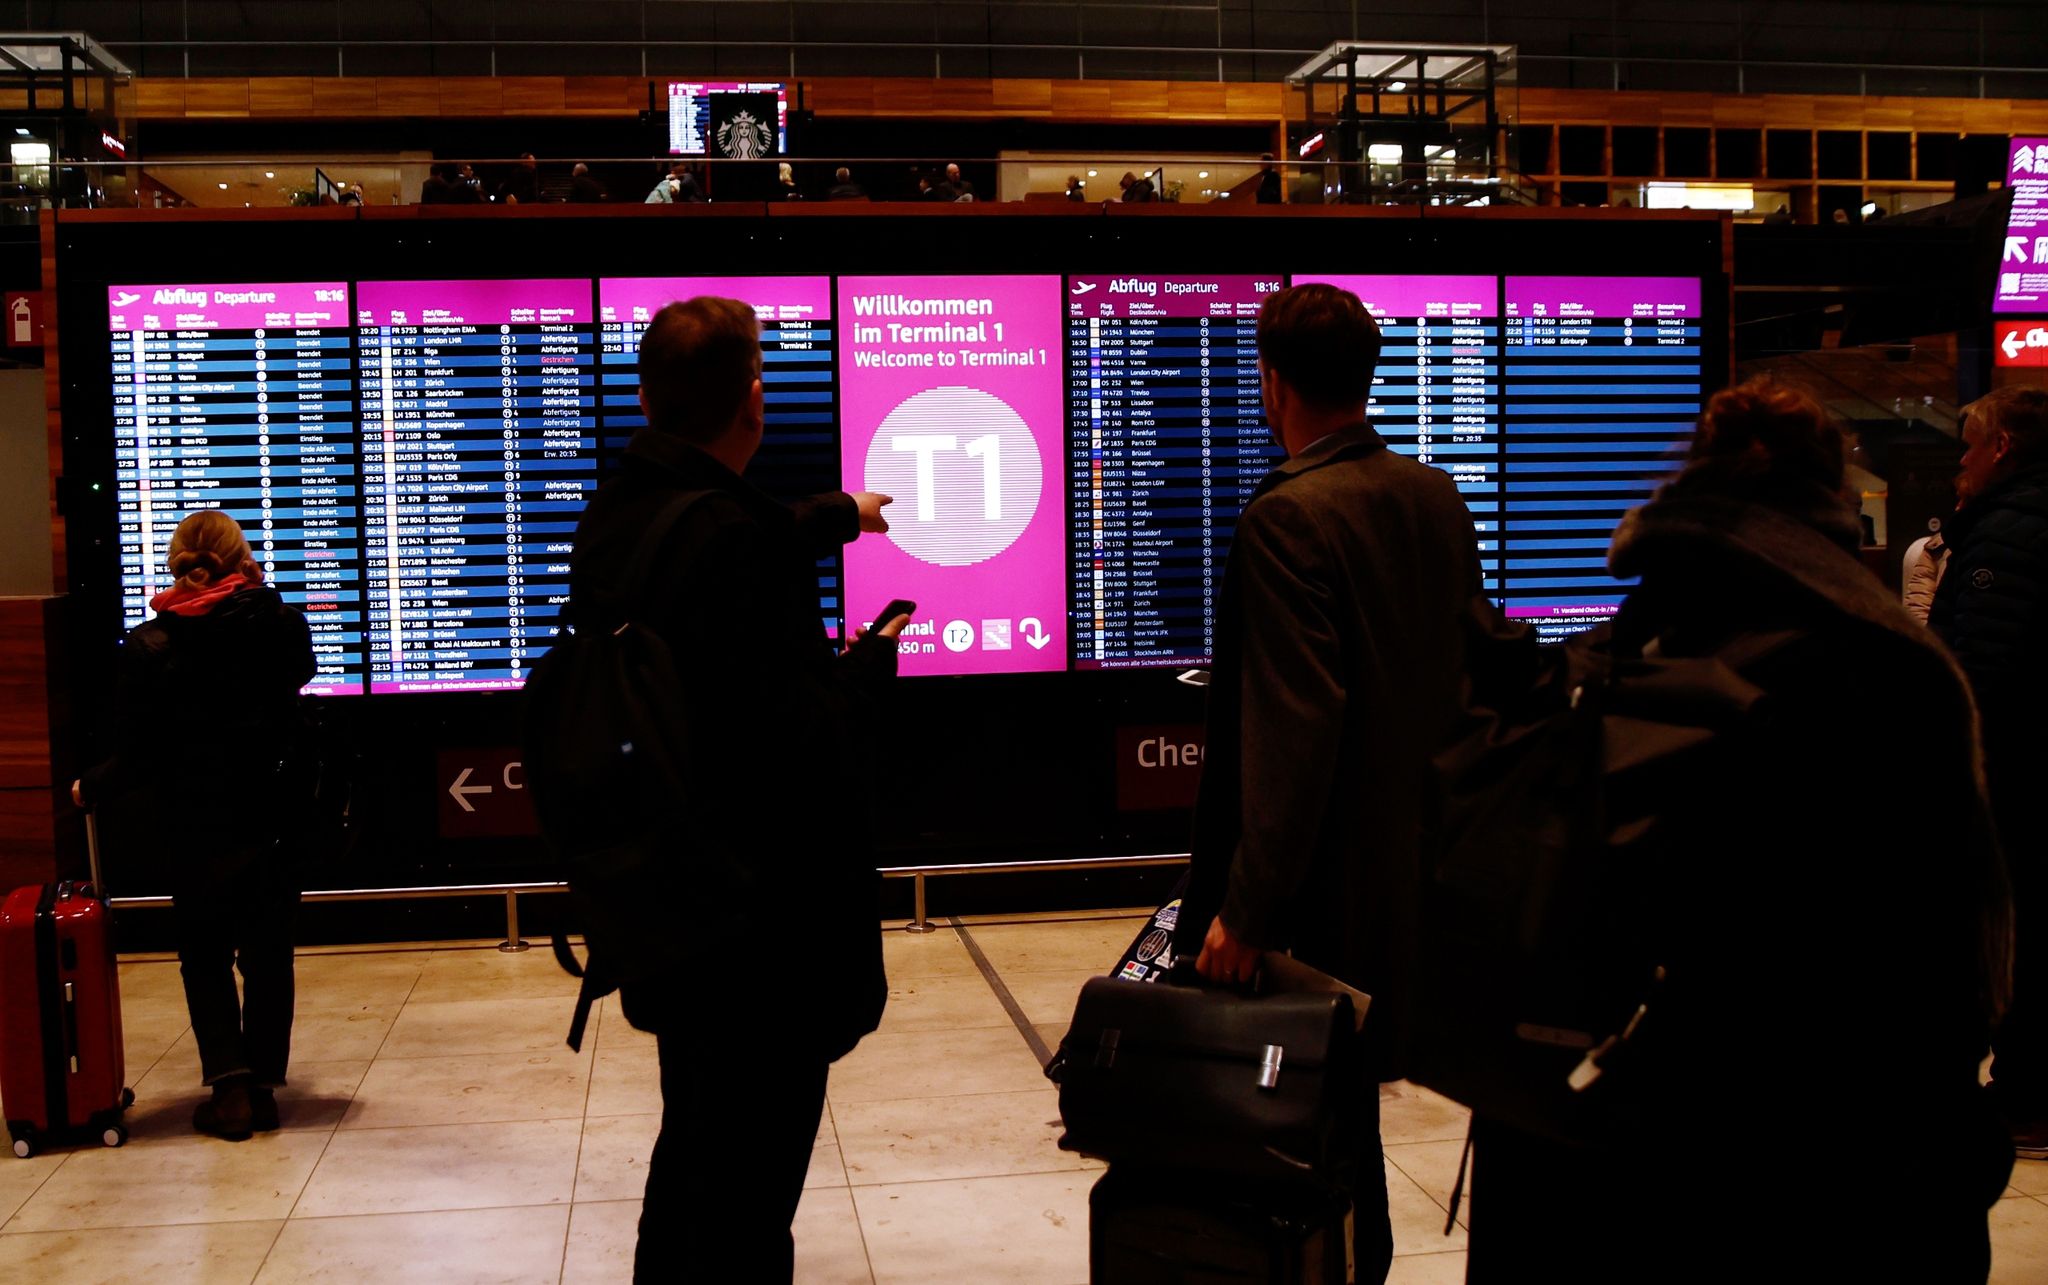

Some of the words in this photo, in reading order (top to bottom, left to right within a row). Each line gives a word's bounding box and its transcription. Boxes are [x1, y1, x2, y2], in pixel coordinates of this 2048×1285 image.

[1109, 278, 1157, 297] Abflug
[1164, 282, 1218, 295] Departure
[1254, 282, 1280, 292] 18:16
[153, 289, 208, 307] Abflug
[214, 291, 276, 306] Departure
[314, 290, 344, 302] 18:16
[853, 295, 993, 316] Willkommen
[1100, 303, 1112, 311] Flug
[1100, 309, 1115, 317] Flight
[779, 321, 807, 329] Terminal
[807, 321, 812, 329] 2
[423, 326, 461, 335] Nottingham
[854, 322, 882, 343] im
[887, 321, 987, 343] Terminal
[993, 323, 1003, 342] 1
[1560, 338, 1588, 346] Edinburgh
[424, 348, 438, 356] Riga
[541, 345, 578, 354] Abfertigung
[854, 350, 934, 367] Welcome
[937, 350, 956, 366] to
[959, 348, 1034, 366] Terminal
[1039, 349, 1046, 365] 1
[1151, 369, 1161, 377] City
[425, 389, 464, 397] Saarbrücken
[513, 388, 518, 396] 2
[542, 387, 579, 396] Abfertigung
[300, 435, 323, 443] Einstieg
[363, 433, 382, 441] 20:15
[405, 432, 422, 440] 1109
[543, 429, 580, 438] Abfertigung
[364, 454, 383, 462] 20:25
[443, 453, 457, 461] Orly
[892, 434, 1001, 521] T1
[366, 496, 384, 504] 20:30
[545, 492, 582, 501] Abfertigung
[948, 629, 968, 643] T2
[923, 643, 935, 653] m
[1141, 658, 1196, 666] Sicherheitskontrollen
